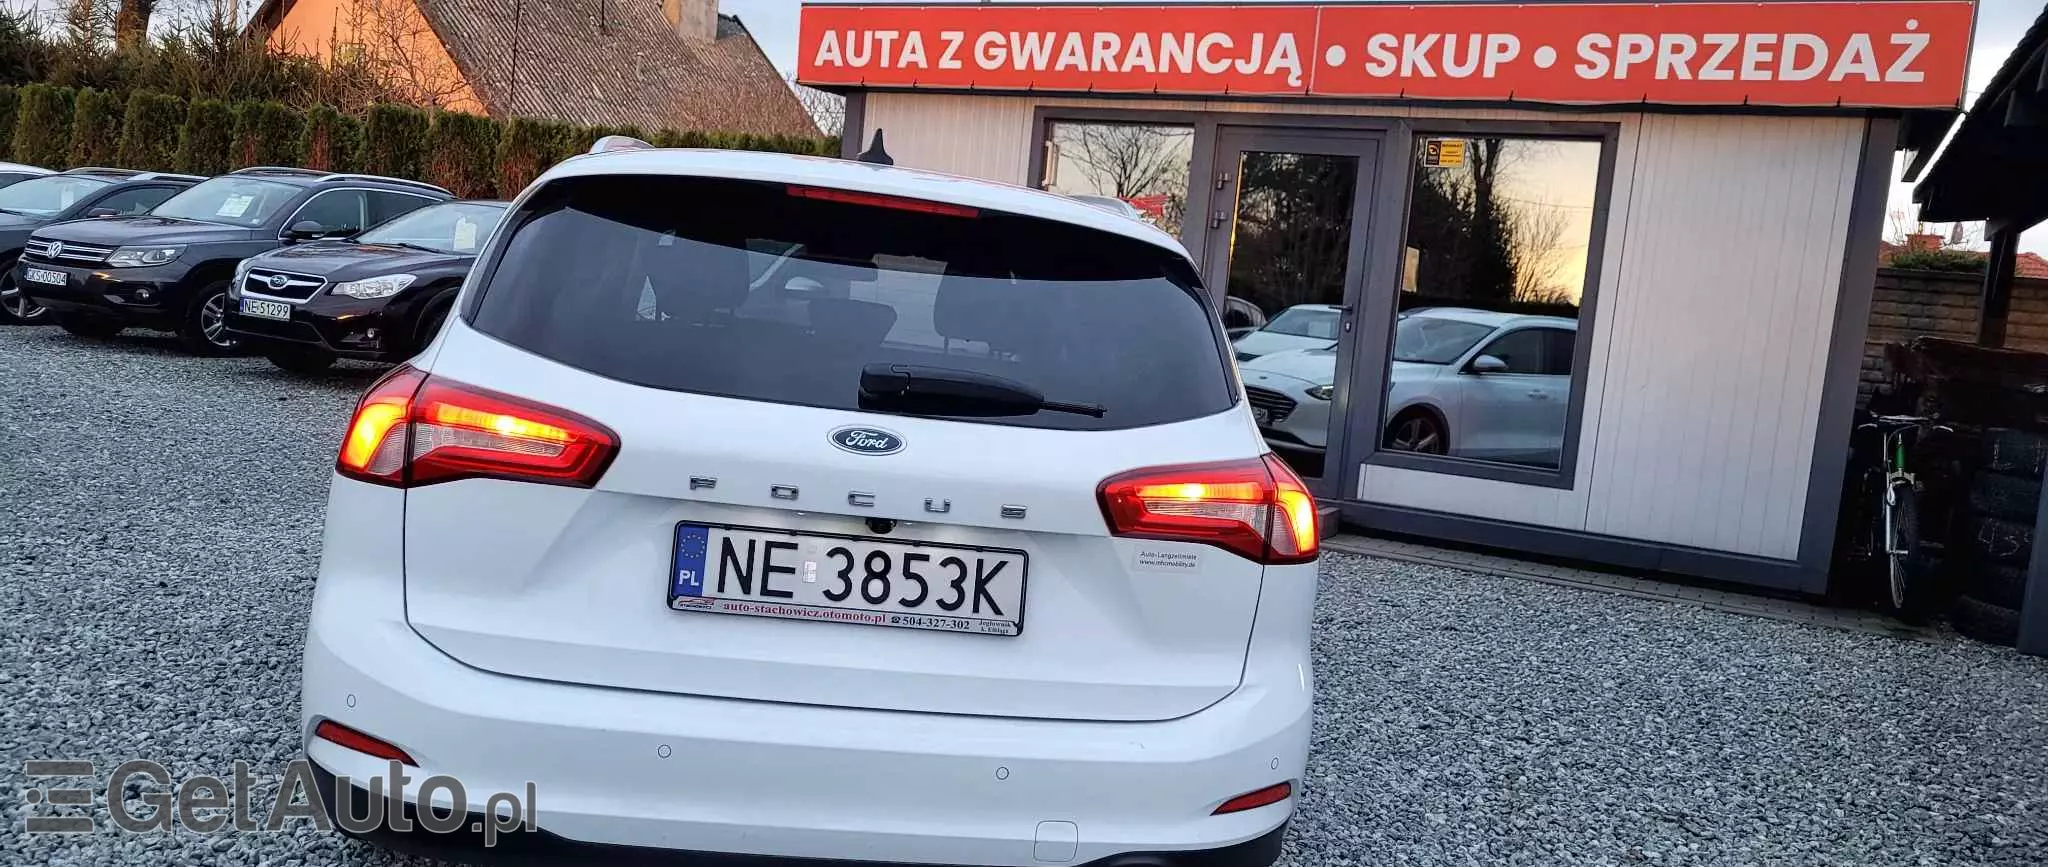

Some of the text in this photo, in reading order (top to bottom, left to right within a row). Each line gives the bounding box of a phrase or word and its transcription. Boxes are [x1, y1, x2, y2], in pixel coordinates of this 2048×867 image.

[814, 30, 1302, 87] AUTA Z GWARANCJĄ
[1365, 33, 1520, 78] SKUP
[1574, 19, 1931, 82] SPRZEDAŻ
[260, 301, 289, 317] 51299
[844, 429, 889, 451] Ford
[689, 474, 1028, 519] FOCUS
[678, 569, 700, 587] PL
[717, 536, 1009, 616] NE 3853K
[722, 602, 970, 630] auto-stachowicz.otomoto.pl 504-327-302
